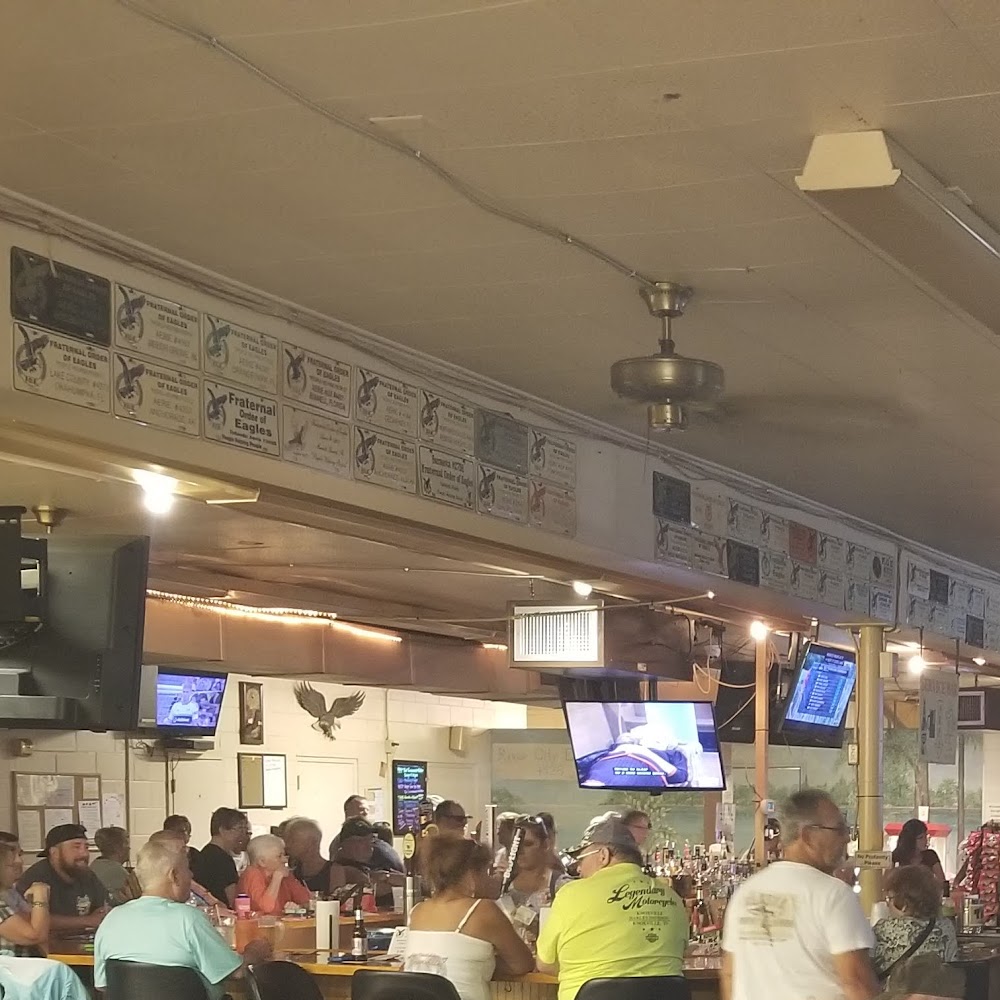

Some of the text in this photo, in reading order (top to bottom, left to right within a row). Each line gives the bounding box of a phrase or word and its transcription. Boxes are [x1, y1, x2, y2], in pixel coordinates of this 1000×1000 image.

[146, 300, 198, 322] FRATERNAL ORDER
[166, 316, 188, 329] EAGLES
[50, 340, 108, 362] FRATERNAL ORDER
[72, 356, 96, 370] EAGLES
[146, 368, 198, 388] FRATERNAL ORDER
[166, 384, 188, 396] EAGLES
[228, 392, 276, 416] Fraternal
[240, 409, 266, 424] Order of
[234, 418, 272, 437] Eagles
[606, 884, 665, 904] Legendary
